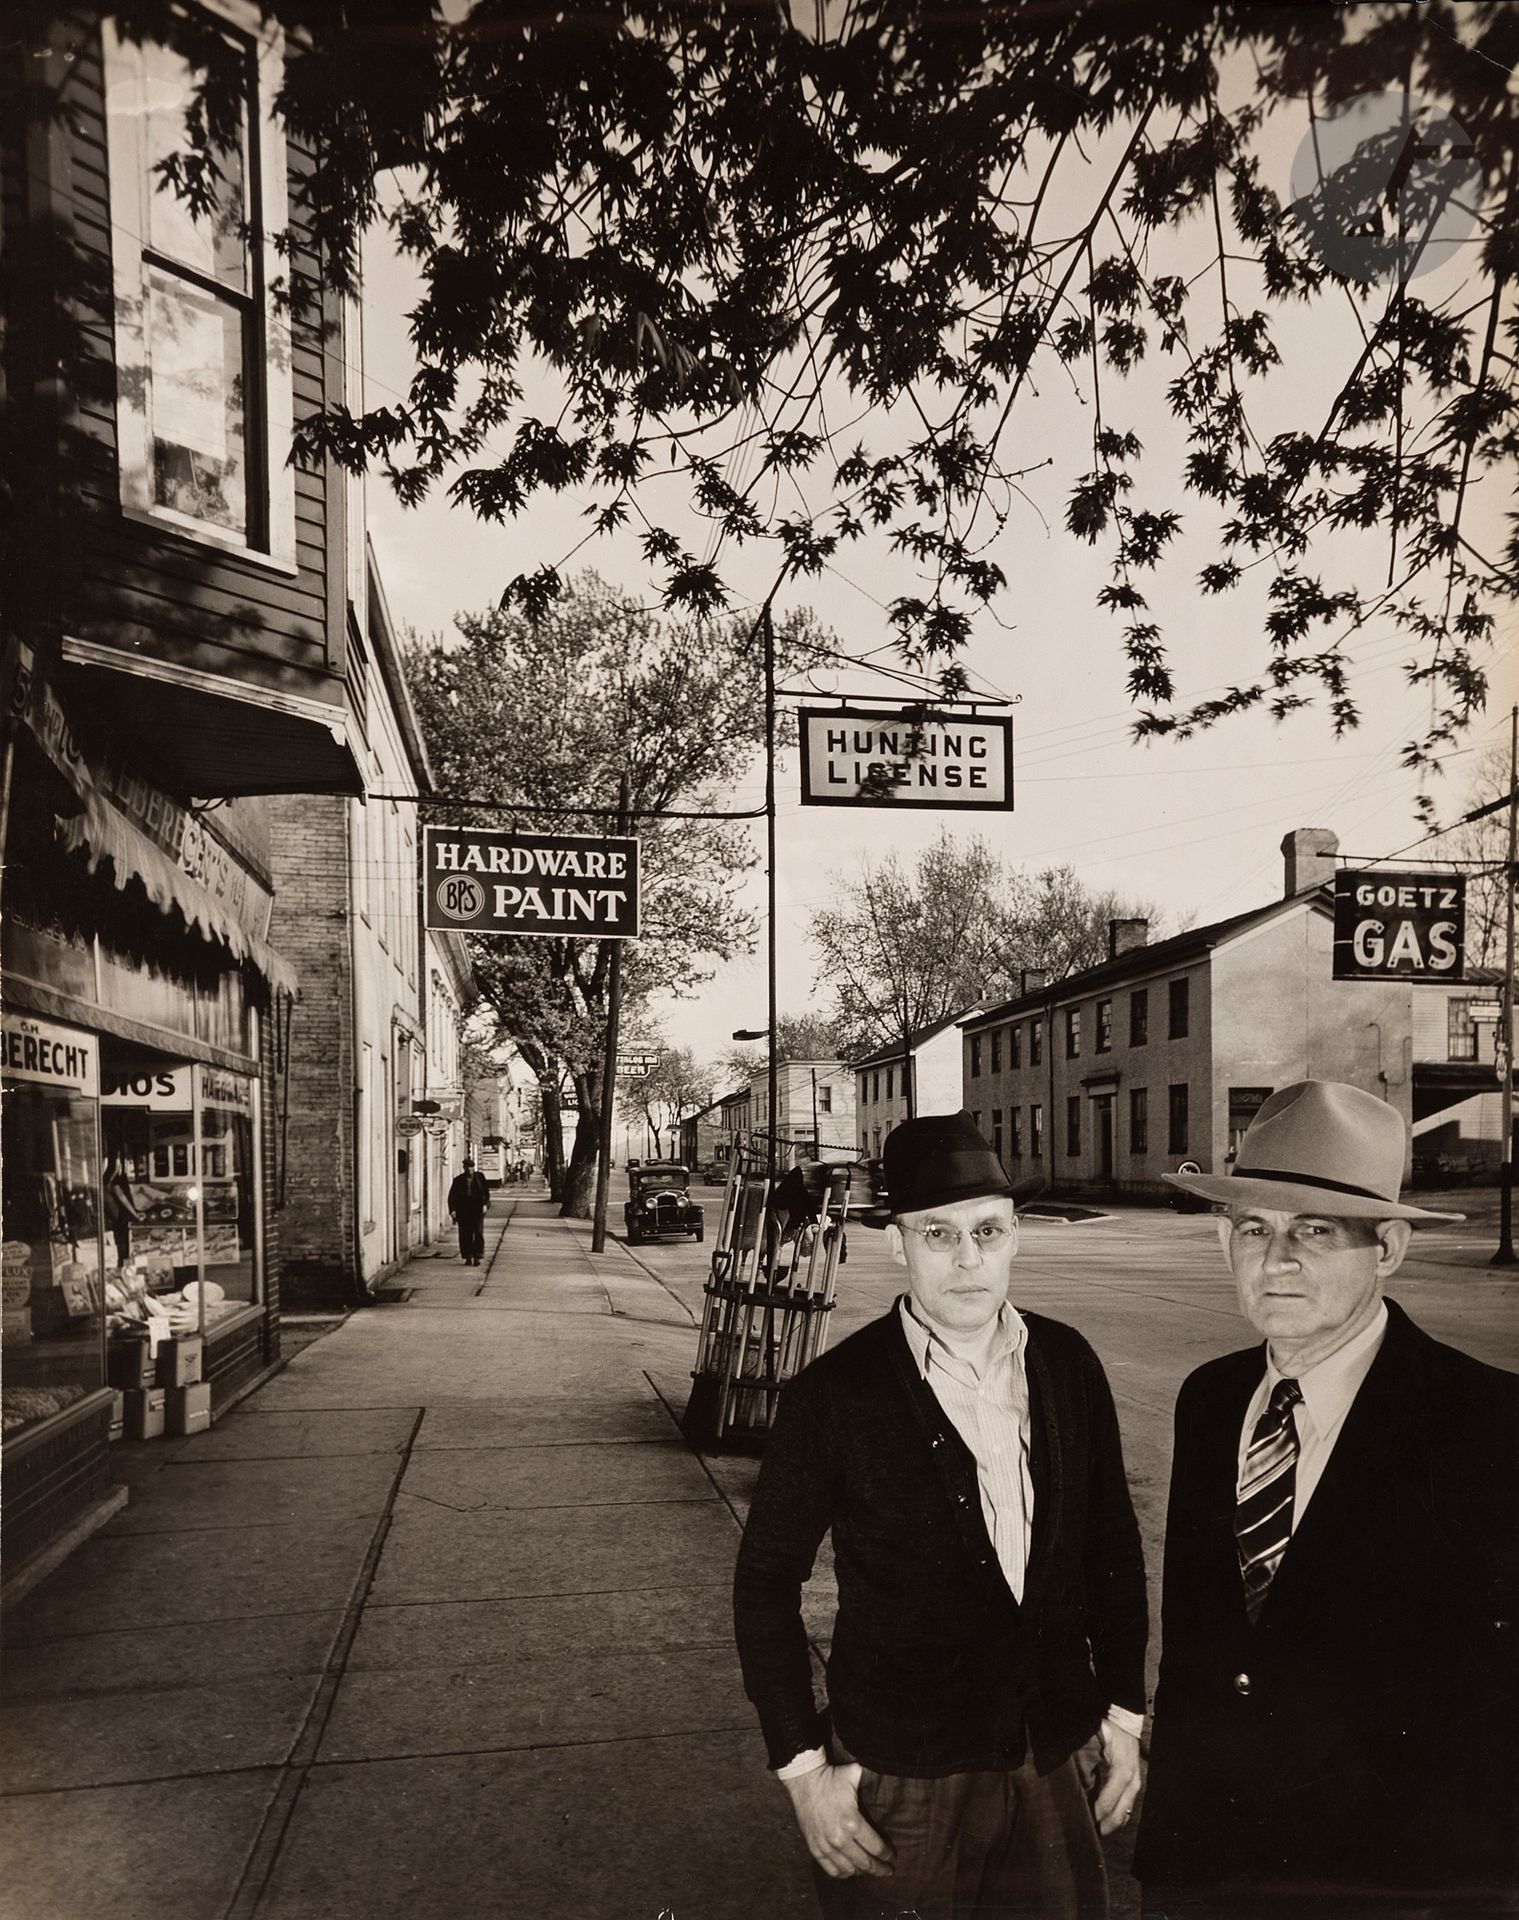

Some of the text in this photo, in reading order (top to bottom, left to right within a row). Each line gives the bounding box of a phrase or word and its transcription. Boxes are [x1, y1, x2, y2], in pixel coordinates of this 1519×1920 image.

[827, 729, 986, 758] HUNTING
[828, 760, 987, 788] LICENSE
[435, 843, 627, 879] HARDWARE
[445, 879, 627, 922] BPS PAINT
[1356, 885, 1458, 908] GOETZ
[1353, 919, 1457, 970] GAS
